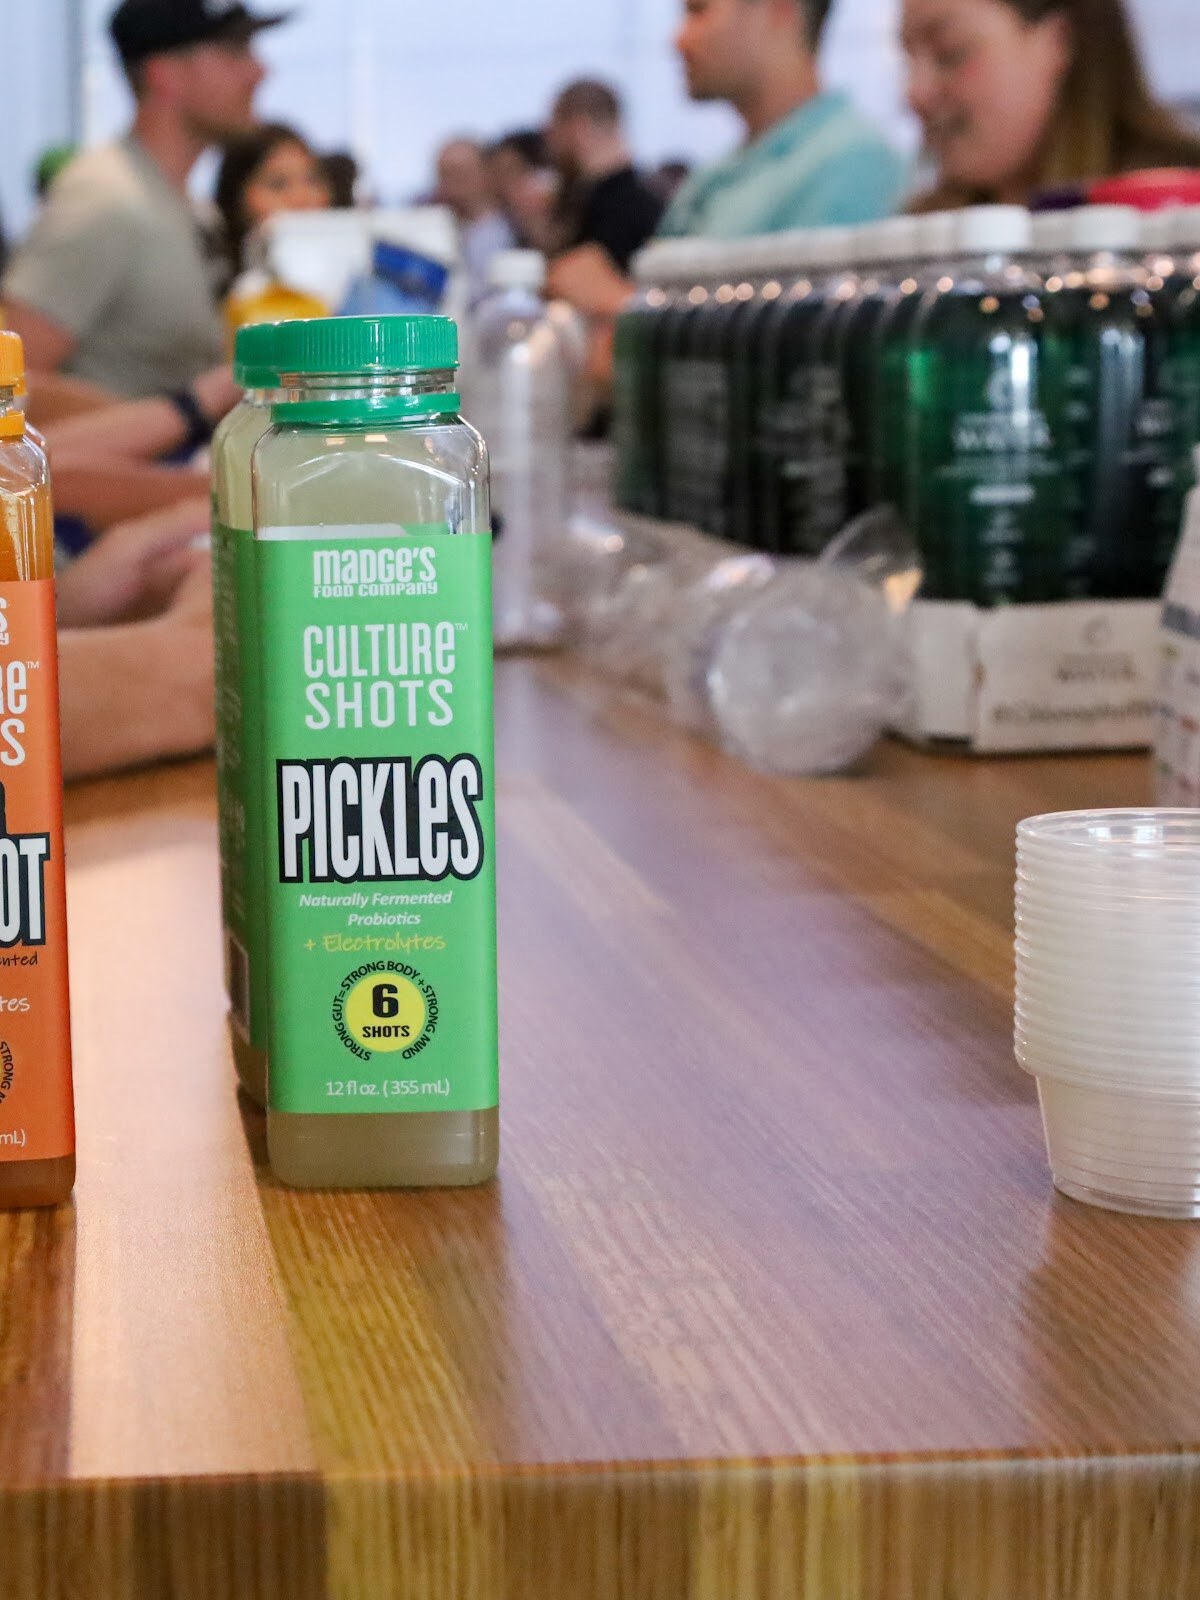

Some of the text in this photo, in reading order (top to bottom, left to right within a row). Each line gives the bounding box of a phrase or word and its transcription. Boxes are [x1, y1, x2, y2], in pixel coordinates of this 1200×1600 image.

[313, 584, 354, 598] FOOD
[305, 679, 453, 730] SHOTS
[299, 890, 453, 908] Naturally Fermented
[347, 912, 421, 926] Probiotics
[322, 931, 447, 954] Electrolytes
[340, 960, 385, 992] STRONG
[386, 960, 421, 980] BODY
[372, 983, 399, 1019] 6
[422, 984, 439, 1034] STRONG
[334, 1021, 372, 1061] STRONG
[362, 1025, 410, 1039] SHOTS
[402, 1034, 431, 1060] MIND
[326, 1081, 344, 1096] 12
